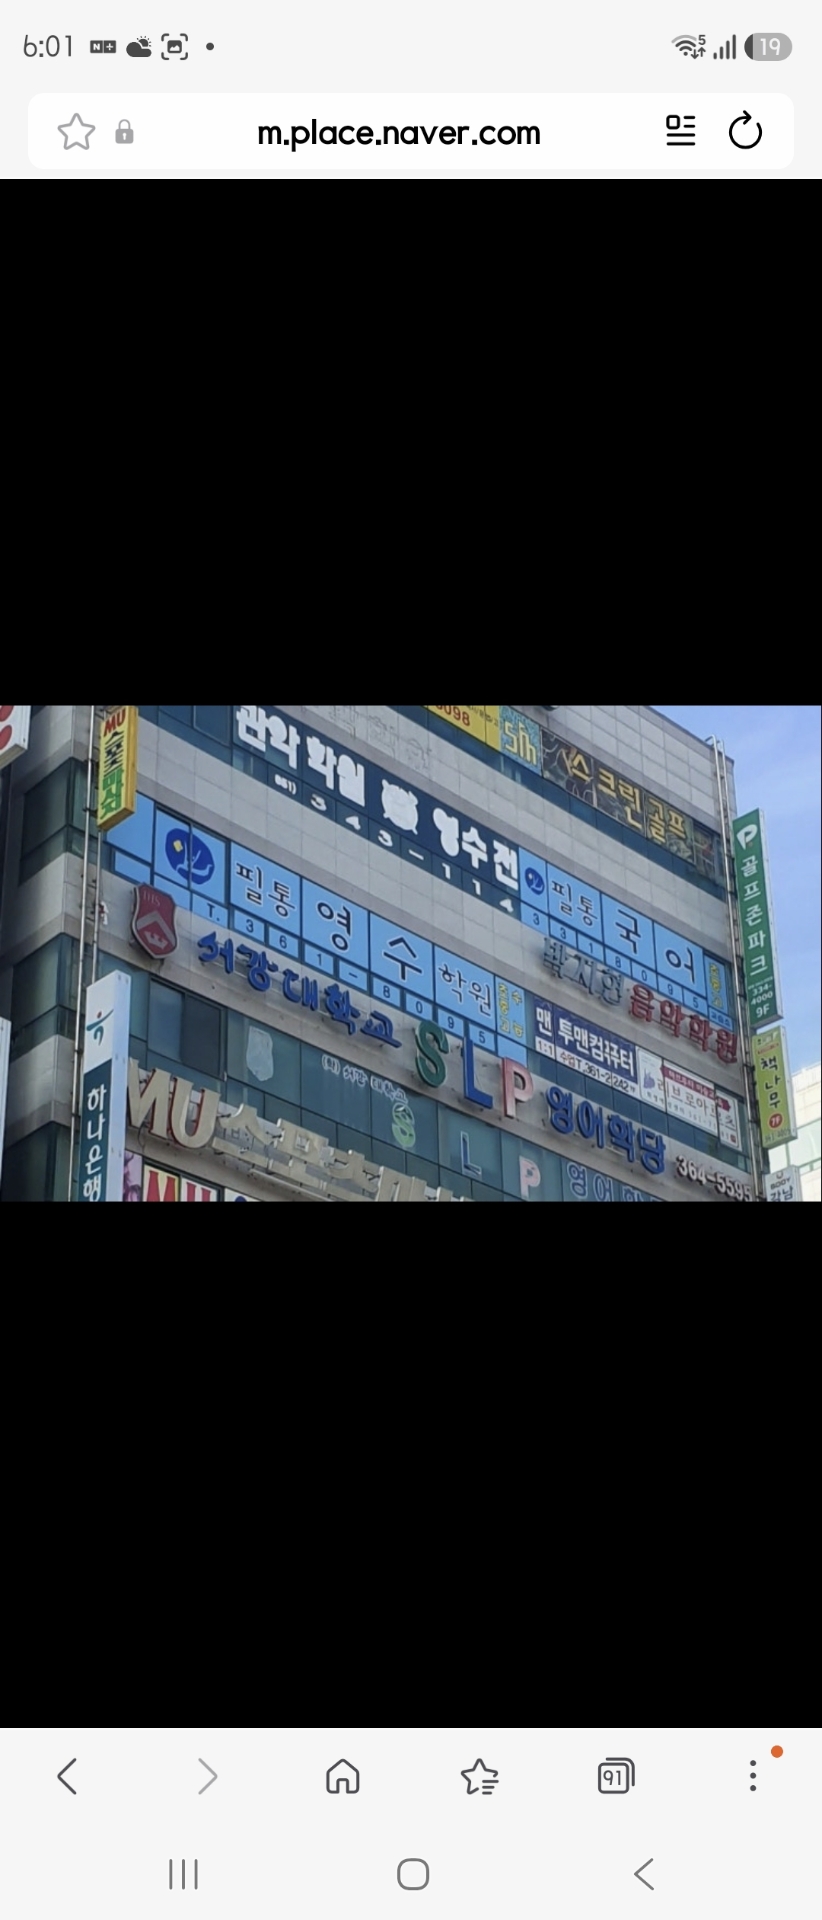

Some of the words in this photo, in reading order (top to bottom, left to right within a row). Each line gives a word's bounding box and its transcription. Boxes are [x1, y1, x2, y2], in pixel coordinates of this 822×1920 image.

[23, 34, 75, 59] 6:01
[759, 37, 782, 56] 19
[257, 119, 542, 152] m.place.naver.com
[103, 707, 126, 737] MU
[306, 736, 365, 807] 학원
[235, 861, 296, 919] 필통
[551, 879, 599, 927] 필통
[740, 856, 769, 977] 골프존파크
[751, 991, 773, 1006] 4000
[756, 1003, 770, 1019] 9F
[630, 983, 738, 1065] 음악학원
[537, 1040, 553, 1057] 1:1
[197, 931, 402, 1048] 서강대학교
[414, 1020, 534, 1118] SLP
[545, 1084, 667, 1175] 영어학당
[676, 1155, 751, 1202] 364-5595
[761, 1055, 781, 1110] 책나무
[83, 1083, 107, 1202] 하나은행
[770, 1176, 791, 1190] BODY
[602, 1769, 622, 1786] 91
